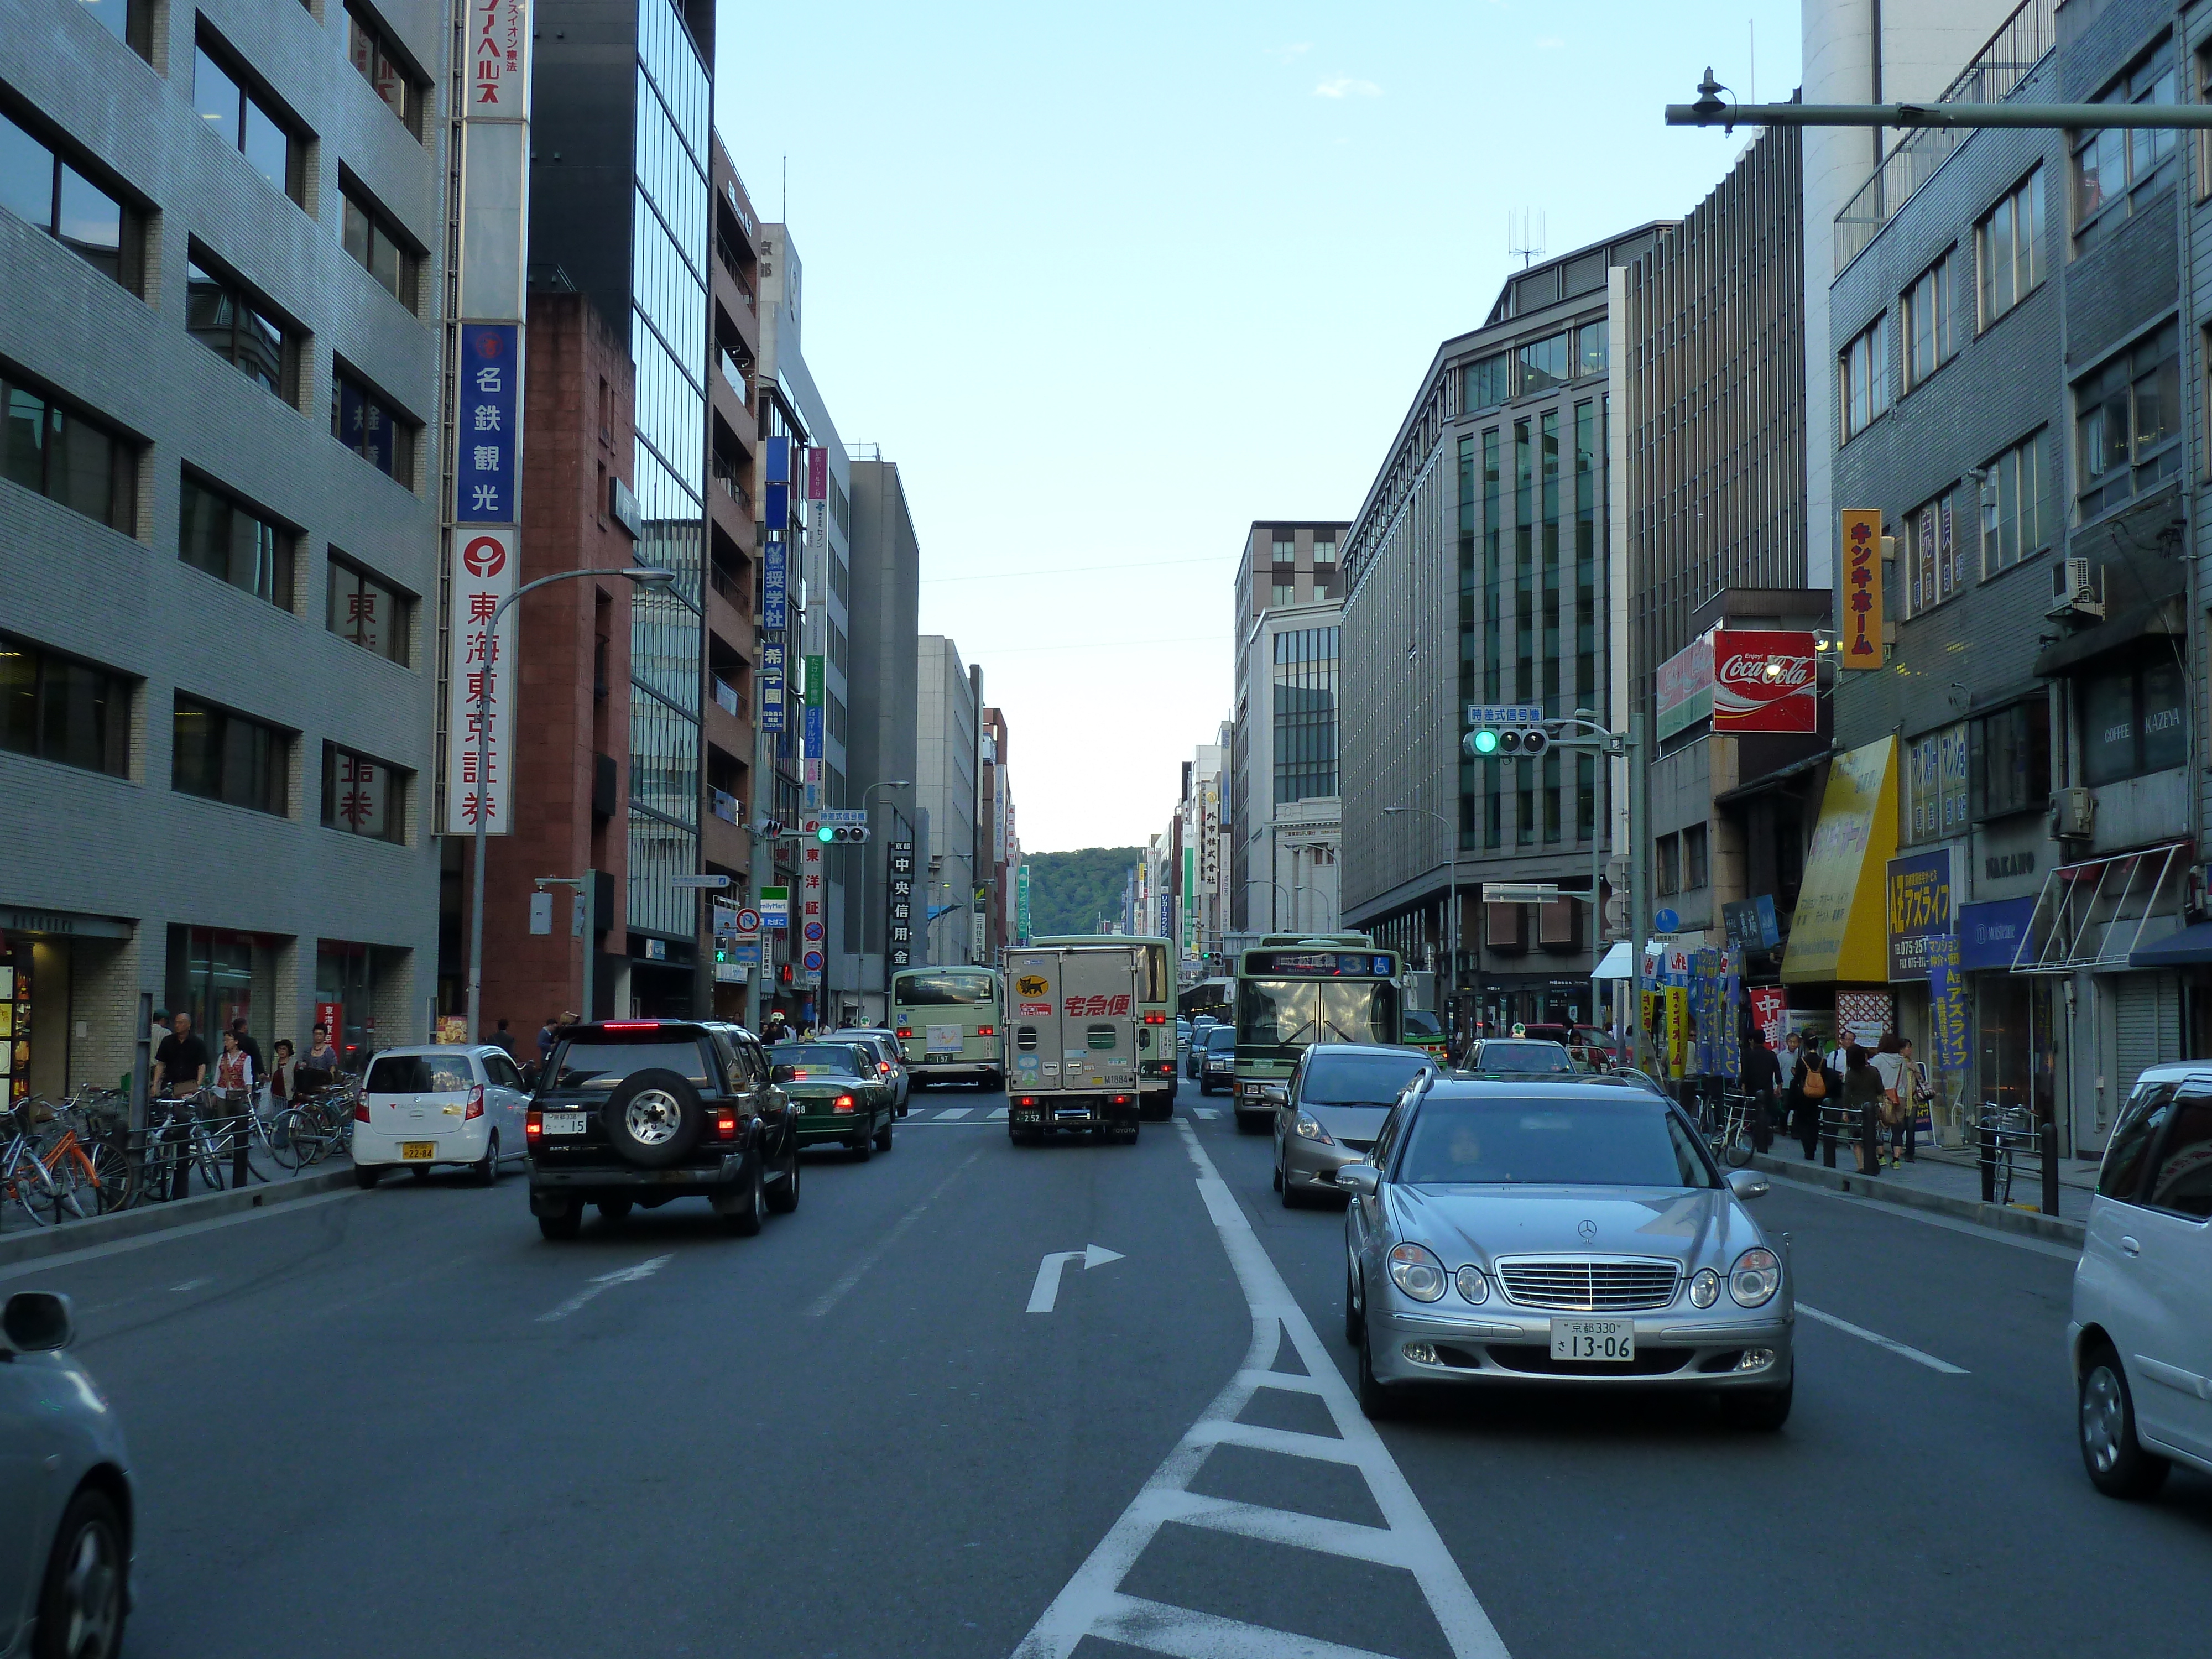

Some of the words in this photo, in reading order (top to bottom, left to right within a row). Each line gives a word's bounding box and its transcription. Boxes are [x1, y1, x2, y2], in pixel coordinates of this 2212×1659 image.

[506, 0, 518, 72] スイオン療法
[472, 367, 502, 510] 名鉄観光
[765, 571, 784, 627] 奨学社
[1851, 523, 1874, 655] キンキホーム
[1720, 654, 1809, 685] Coca-Cola
[462, 591, 500, 826] 東海東京証券
[1472, 708, 1540, 722] 時差式信号機
[2105, 723, 2130, 742] COFFEE
[2145, 707, 2179, 733] KAZEYA
[1207, 811, 1217, 884] 外市株式會社
[805, 848, 820, 915] 東洋証
[894, 858, 910, 964] 中央信用金
[1905, 884, 1949, 927] アズライフ
[1344, 957, 1362, 972] 3
[1929, 940, 1960, 952] マンション
[1064, 994, 1131, 1017] 宅急便
[1755, 995, 1781, 1047] 中華
[1947, 987, 1968, 1065] アズライフ
[1104, 1075, 1128, 1084] M1884
[409, 1150, 432, 1159] 22-84
[1558, 1340, 1565, 1352] さ
[1573, 1336, 1630, 1358] 13-06
[1571, 1323, 1616, 1334] 京都330
